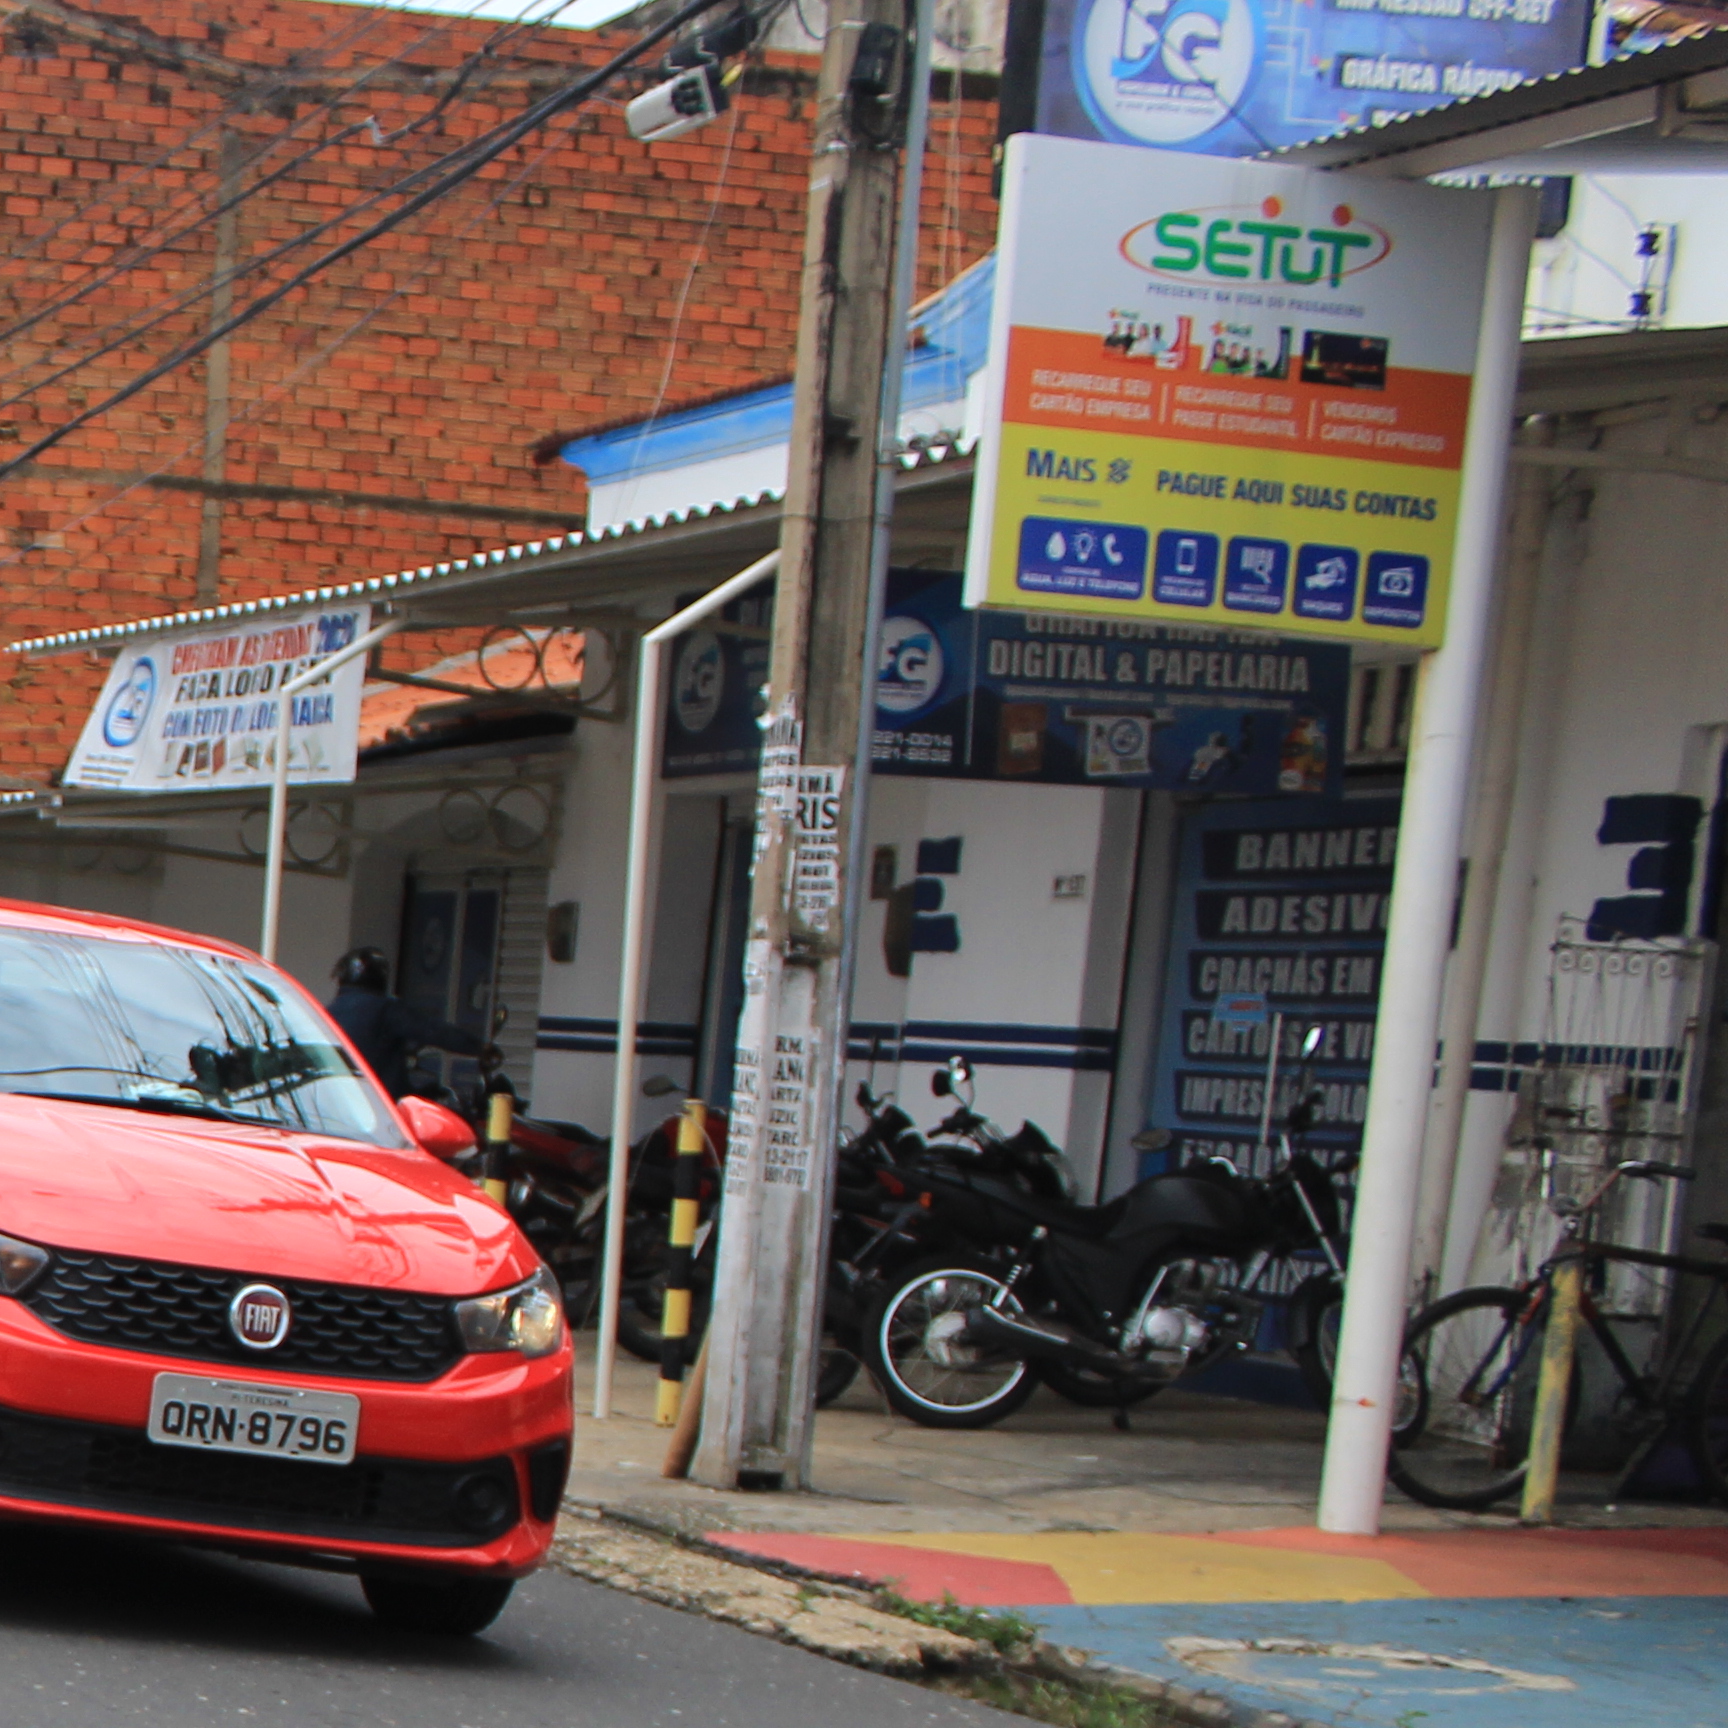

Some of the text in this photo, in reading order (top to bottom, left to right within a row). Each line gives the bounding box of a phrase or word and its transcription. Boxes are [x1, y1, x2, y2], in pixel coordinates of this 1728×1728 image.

[1151, 211, 1373, 290] SETUT
[1156, 469, 1438, 522] PAGUE AQUI SUAS CONTAS
[988, 638, 1310, 693] DIGITAL & PAPELARIA
[1200, 950, 1373, 994] CRACHÁS EM
[245, 1303, 281, 1334] FIAT
